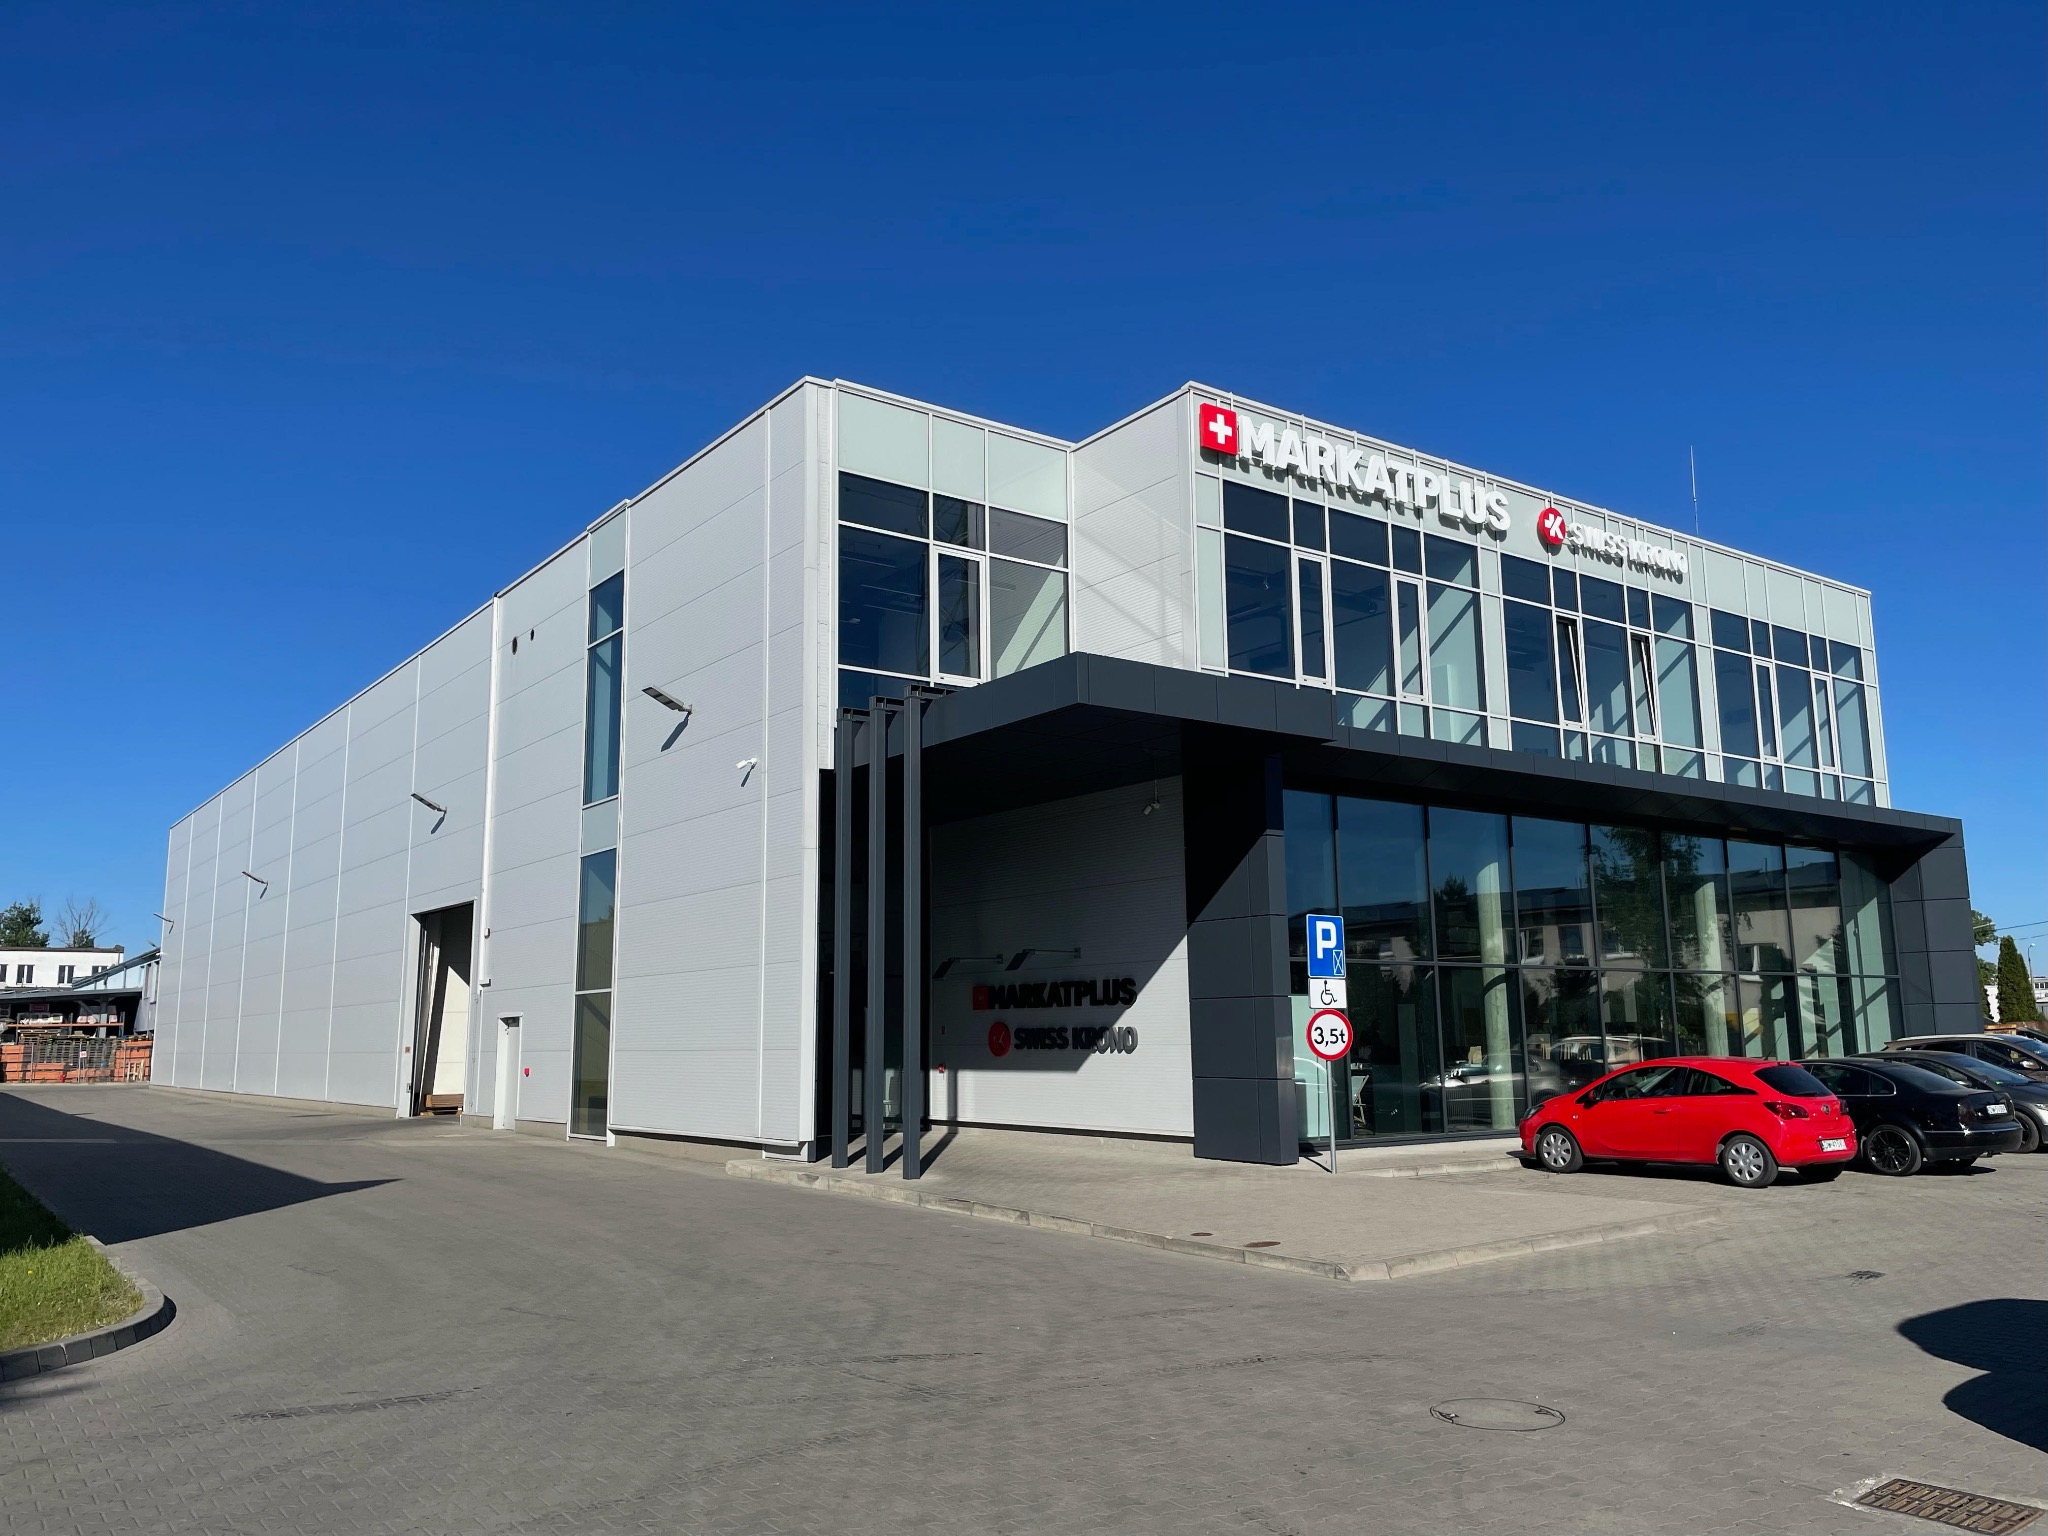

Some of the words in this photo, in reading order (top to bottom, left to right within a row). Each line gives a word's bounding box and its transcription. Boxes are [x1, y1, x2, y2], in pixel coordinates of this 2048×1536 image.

[1238, 414, 1511, 532] MARKATPLUS
[1568, 522, 1627, 557] SWISS
[1628, 538, 1689, 574] KRONO
[1315, 920, 1337, 959] P
[990, 977, 1138, 1010] MARKATPLUS
[1013, 1026, 1069, 1050] SWISS
[1072, 1026, 1139, 1055] KRONO
[1313, 1026, 1346, 1048] 3,5t
